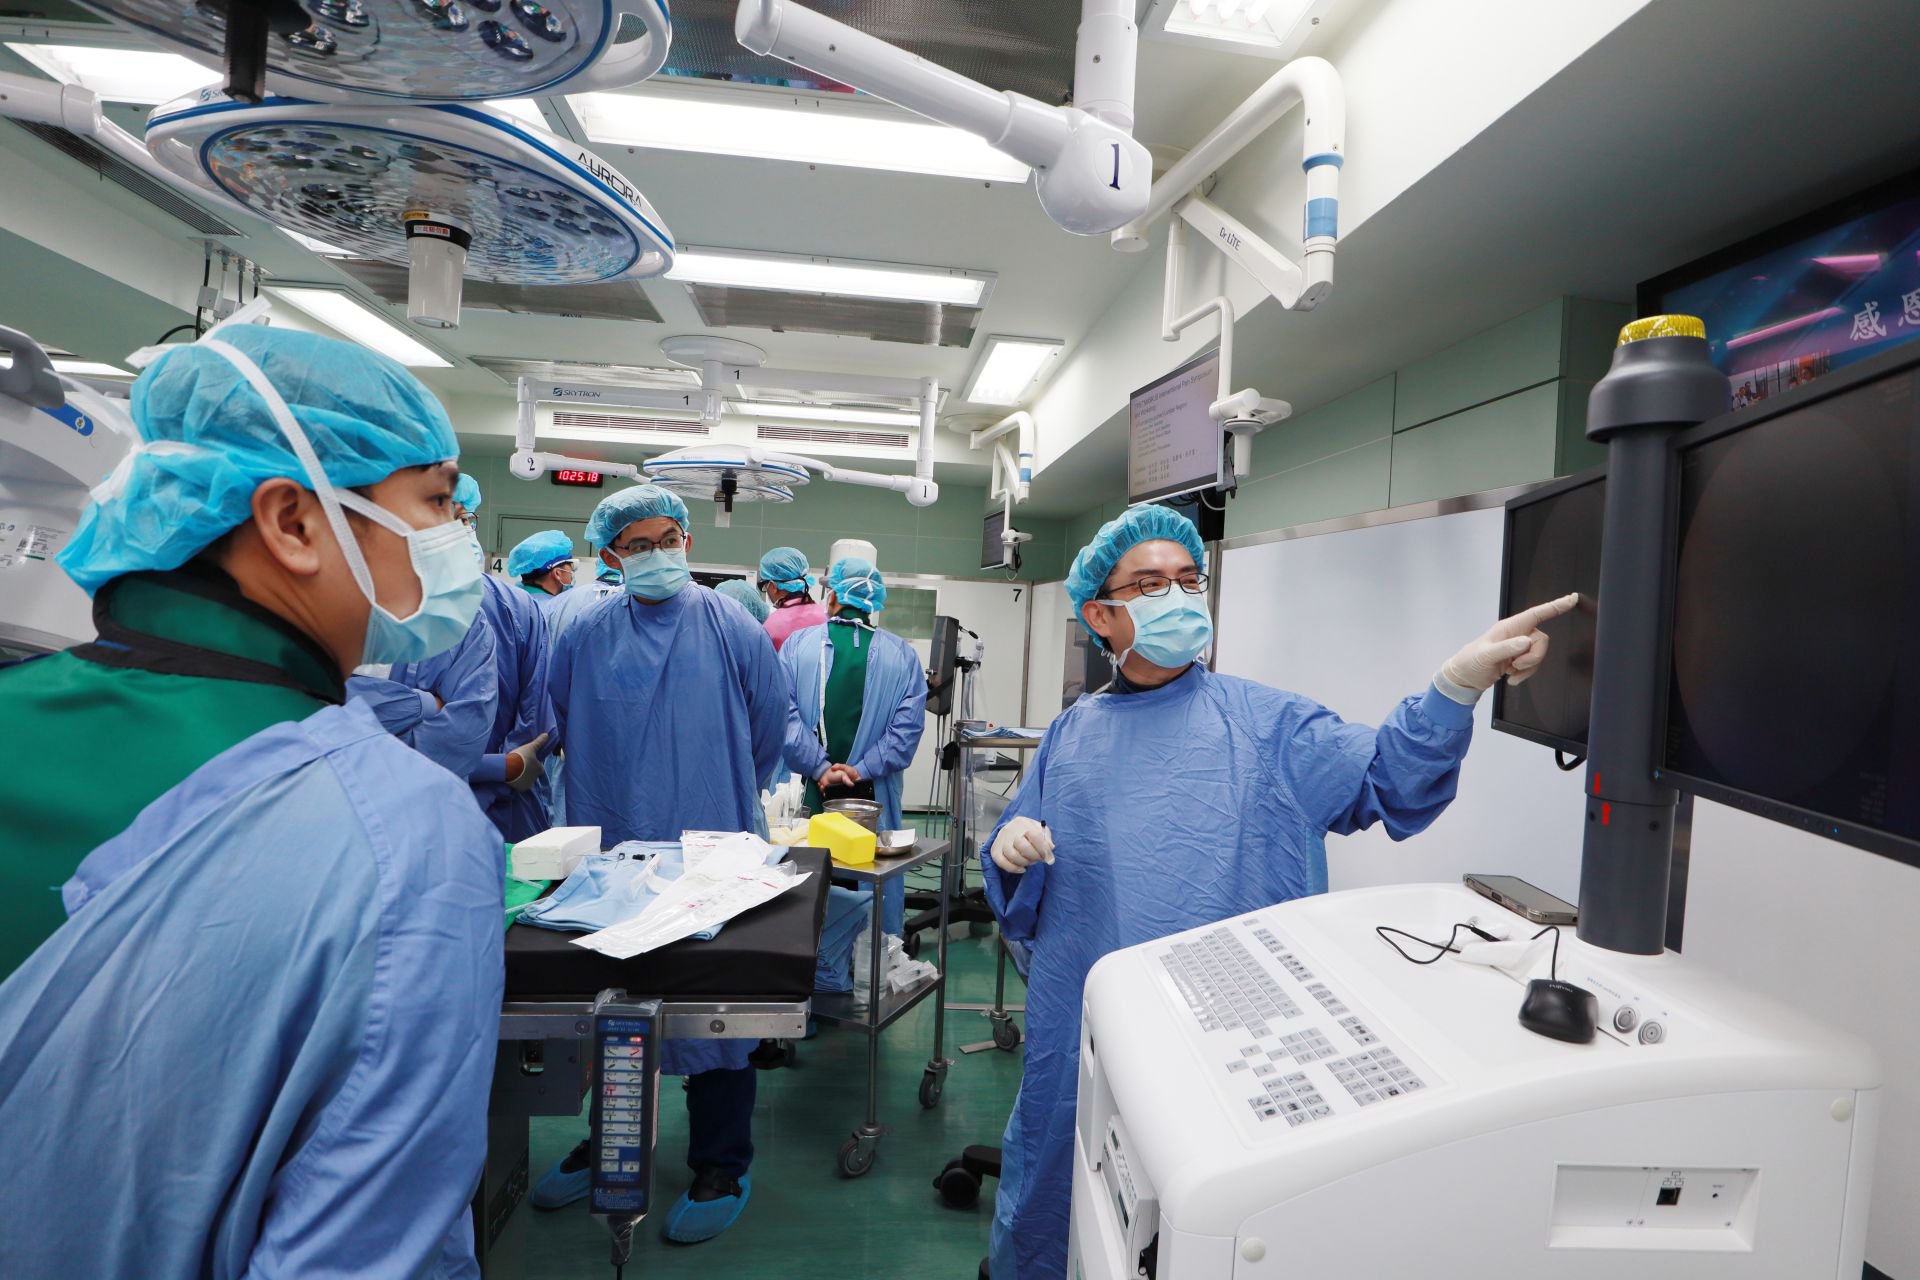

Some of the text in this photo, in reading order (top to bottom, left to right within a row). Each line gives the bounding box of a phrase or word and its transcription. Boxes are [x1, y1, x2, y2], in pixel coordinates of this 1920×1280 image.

[1109, 143, 1121, 190] 1
[578, 152, 642, 207] AURORA
[733, 369, 740, 380] 1
[562, 389, 601, 398] SKYTRON
[683, 395, 689, 405] 1
[527, 456, 536, 471] 2
[492, 558, 503, 573] 4
[1012, 588, 1022, 602] 7
